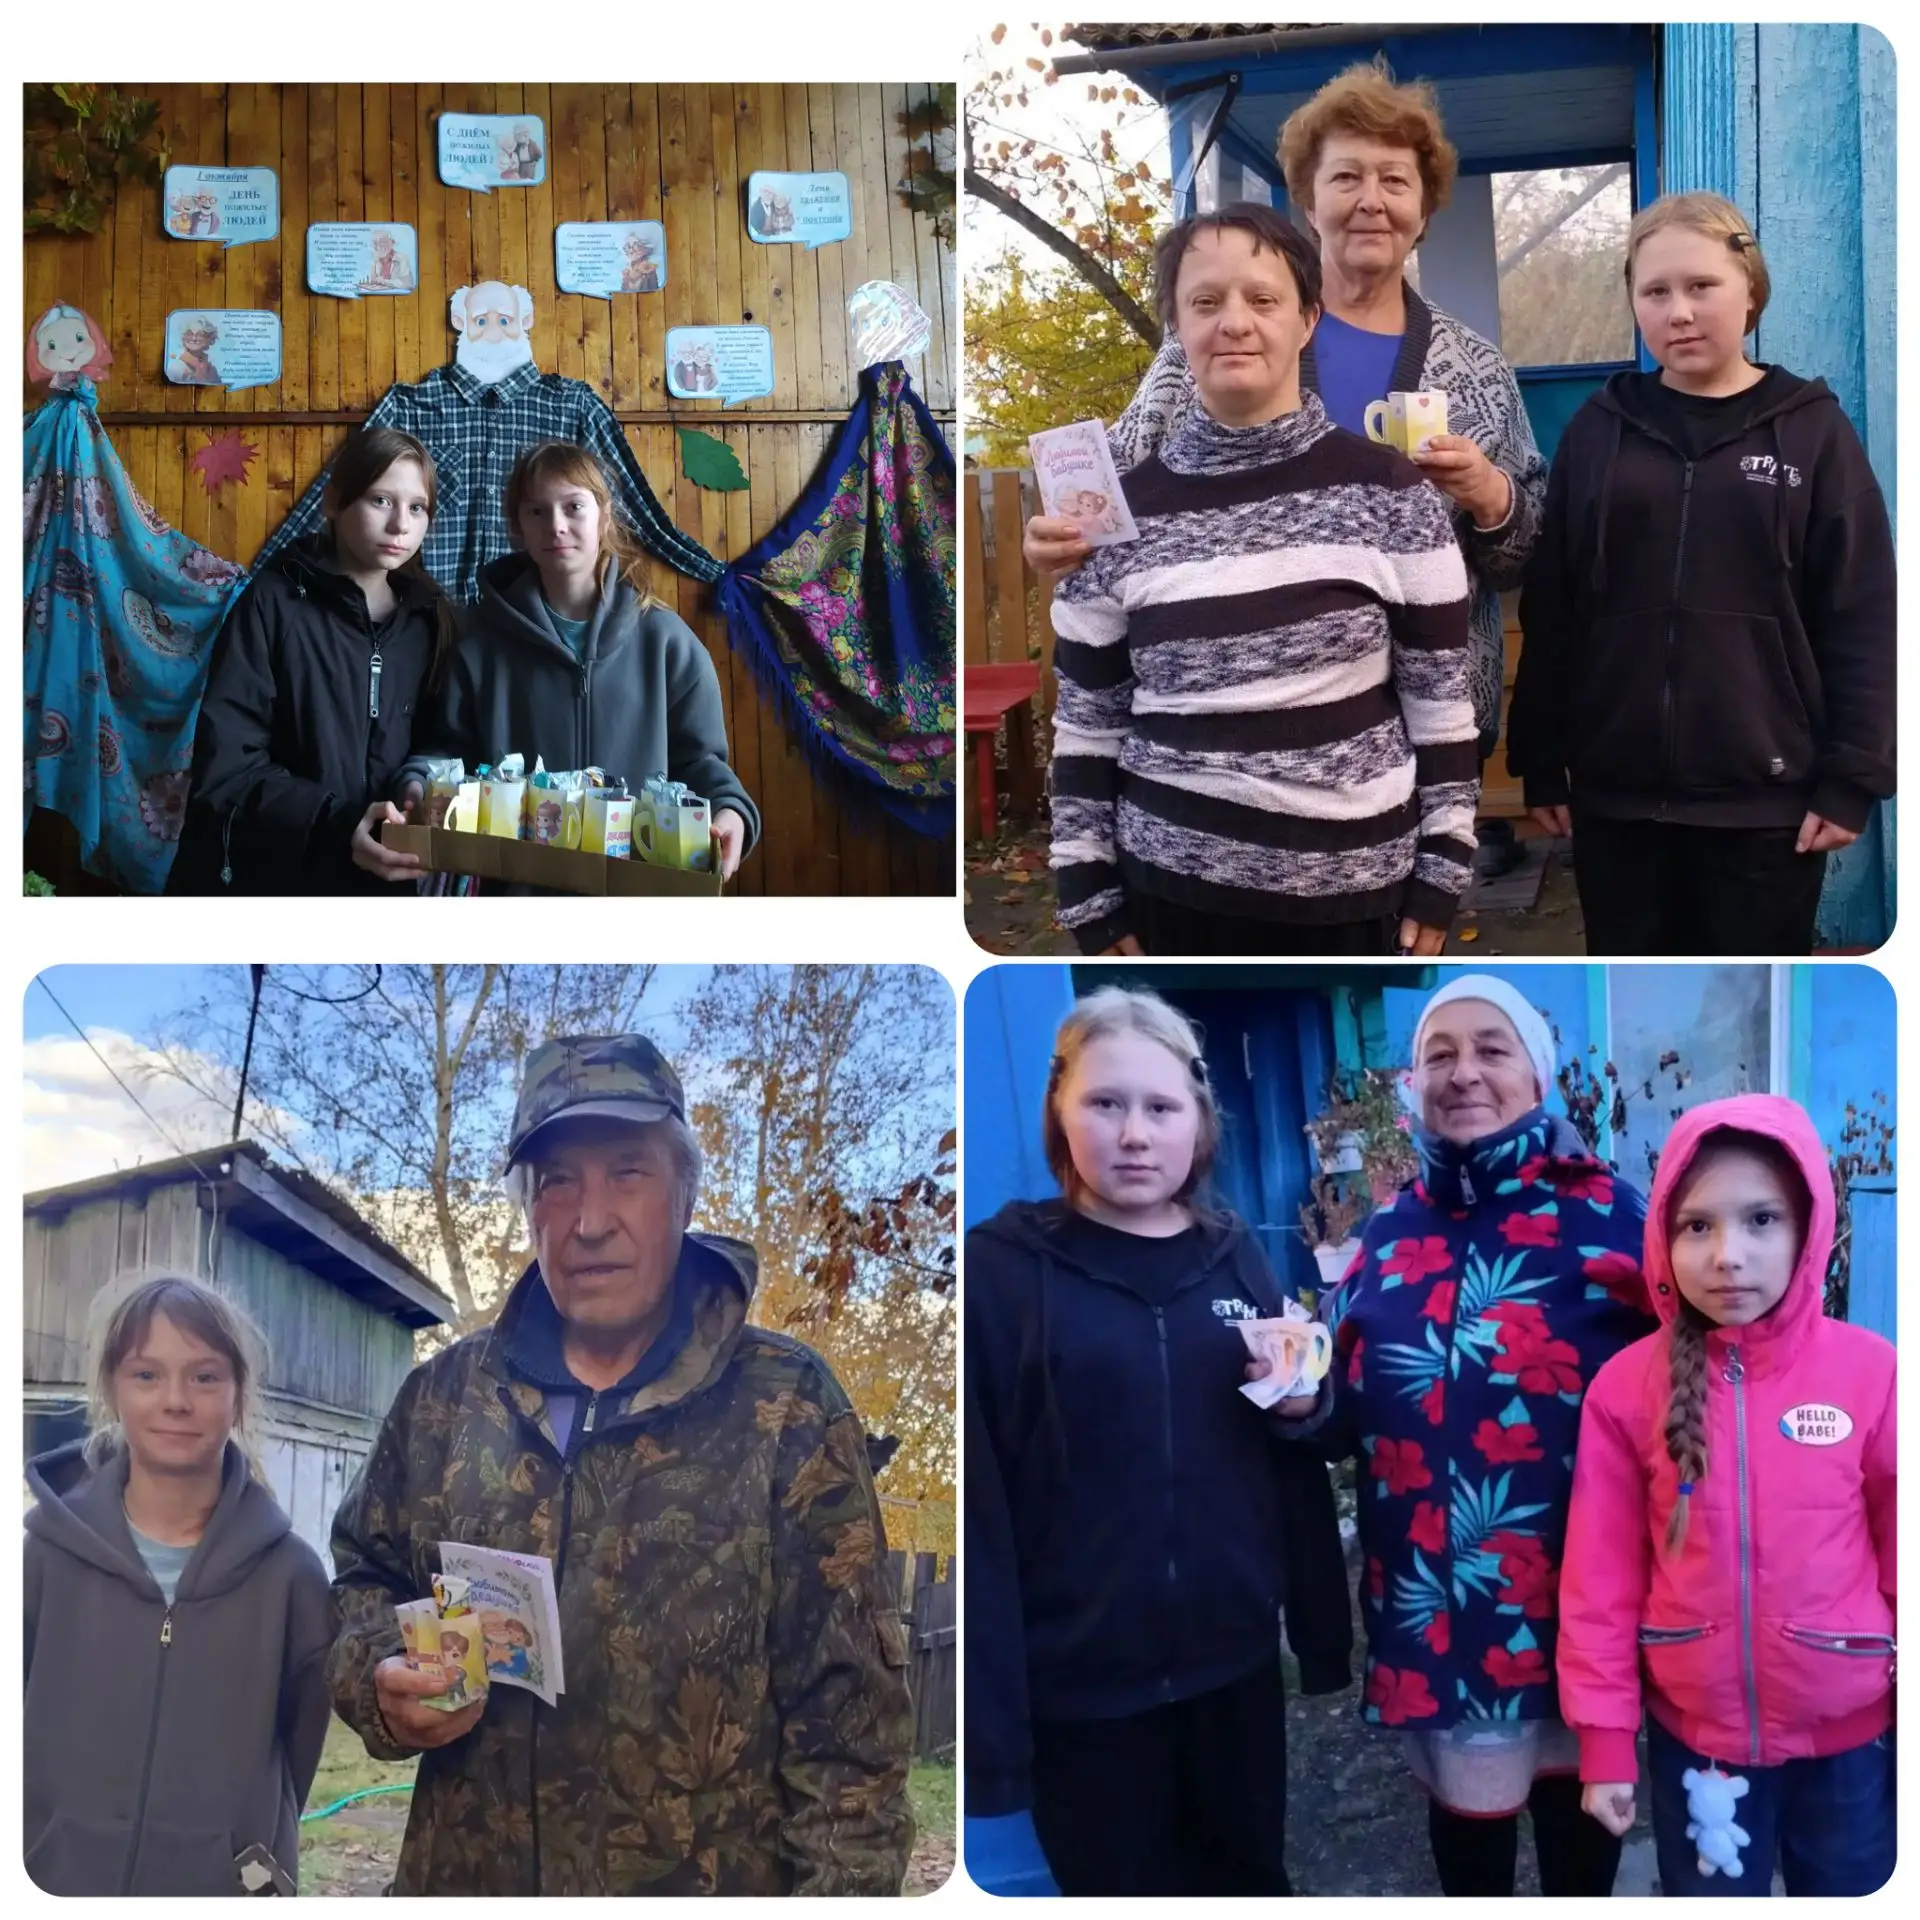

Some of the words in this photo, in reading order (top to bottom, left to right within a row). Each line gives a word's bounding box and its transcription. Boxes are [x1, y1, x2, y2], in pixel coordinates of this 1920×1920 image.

[229, 189, 261, 200] ДЕНЬ
[222, 214, 267, 227] ЛЮДЕЙ
[1796, 1408, 1836, 1423] HELLO
[1797, 1424, 1836, 1438] BABE!
